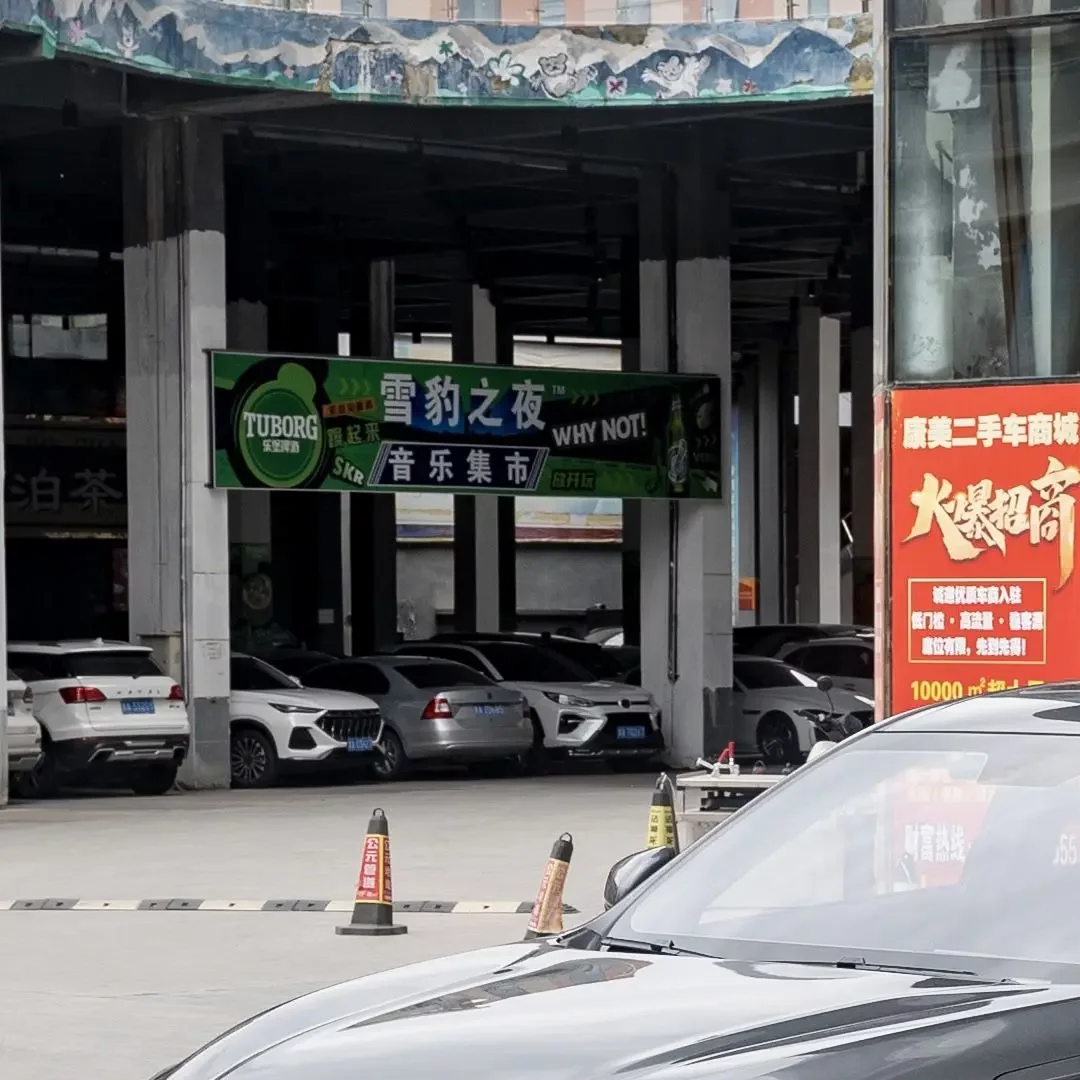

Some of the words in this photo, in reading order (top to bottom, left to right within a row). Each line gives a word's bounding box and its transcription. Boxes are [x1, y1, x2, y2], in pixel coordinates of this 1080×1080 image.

[380, 374, 546, 430] 雪豹之夜
[243, 411, 318, 440] TUBORG
[552, 422, 596, 446] WHY
[602, 412, 647, 442] NOT!
[903, 412, 1080, 449] 康美二手车商城
[333, 455, 364, 485] SKR
[388, 447, 529, 484] 音乐集市
[9, 467, 123, 513] 泊茶
[911, 680, 963, 701] 10000
